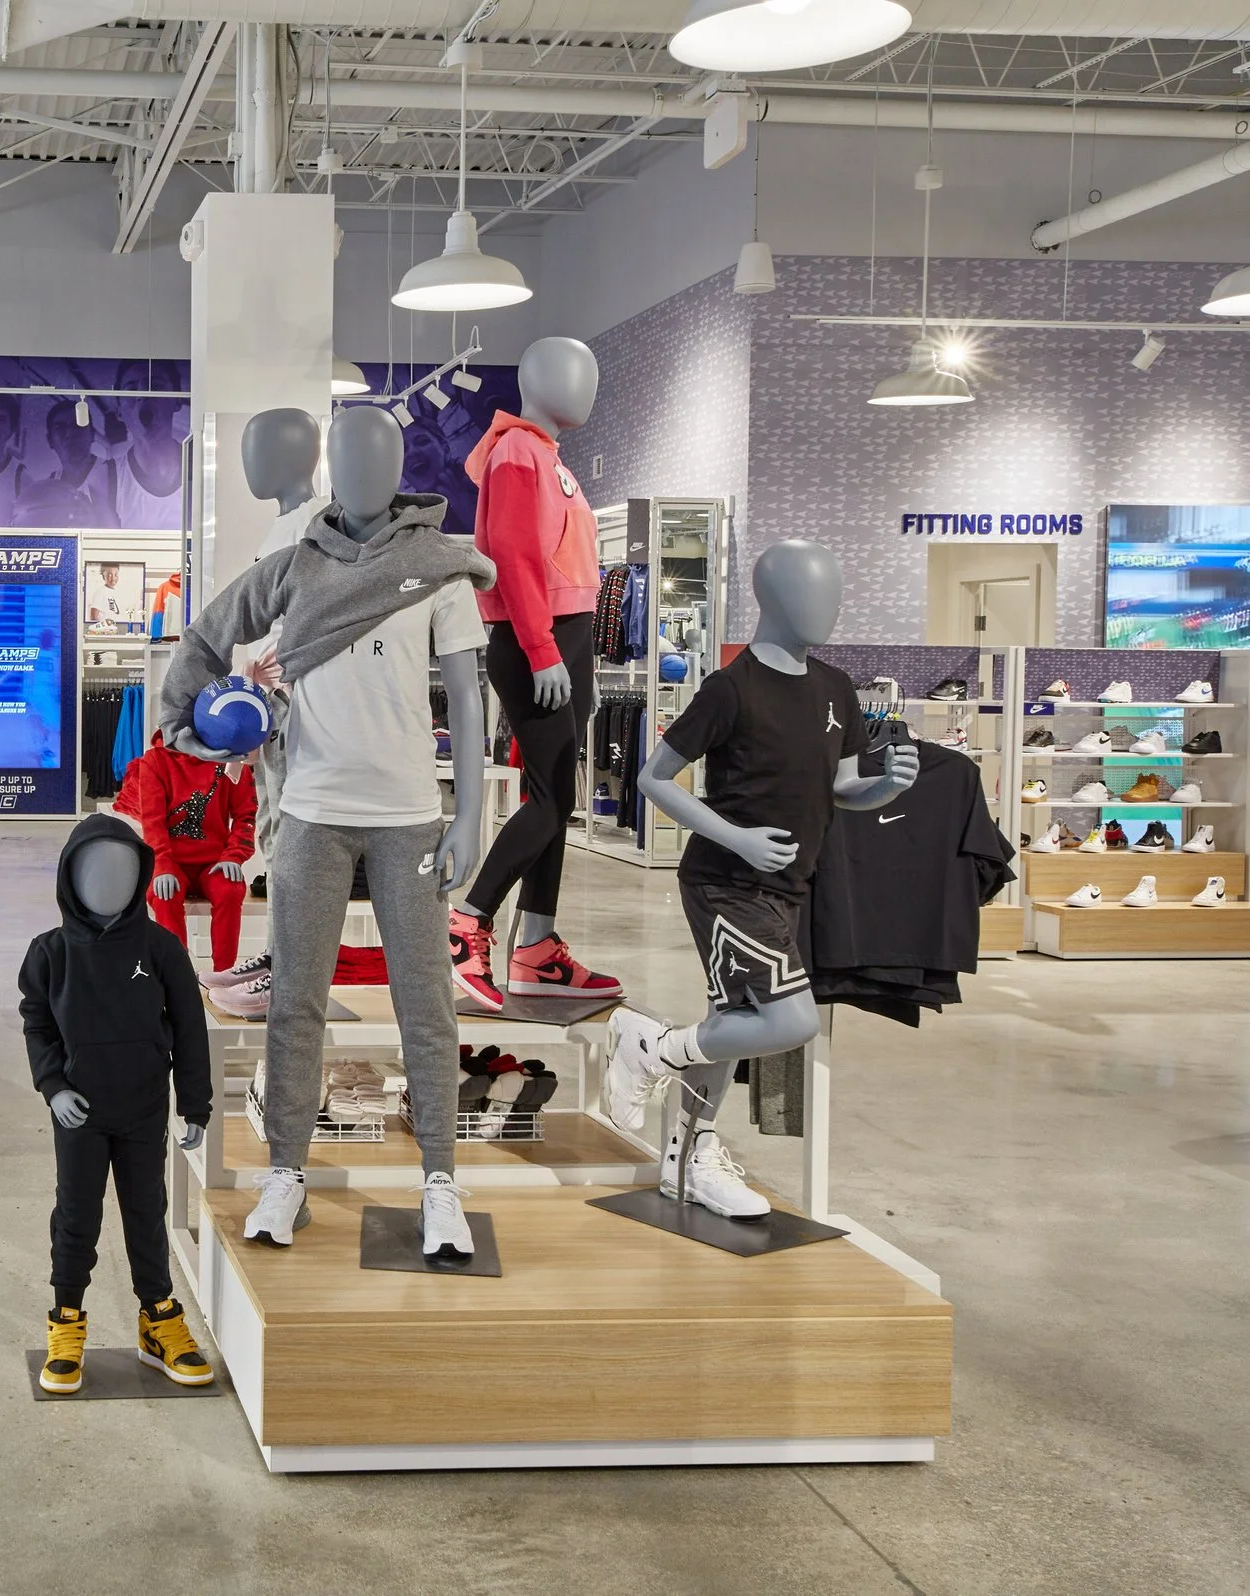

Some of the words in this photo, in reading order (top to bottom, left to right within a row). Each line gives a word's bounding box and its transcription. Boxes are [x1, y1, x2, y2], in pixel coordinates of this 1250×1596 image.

[902, 513, 992, 535] FITTING
[999, 514, 1083, 535] ROOMS
[403, 578, 422, 587] NIKE
[7, 775, 20, 784] UP
[21, 776, 33, 784] TO
[23, 785, 36, 794] UP
